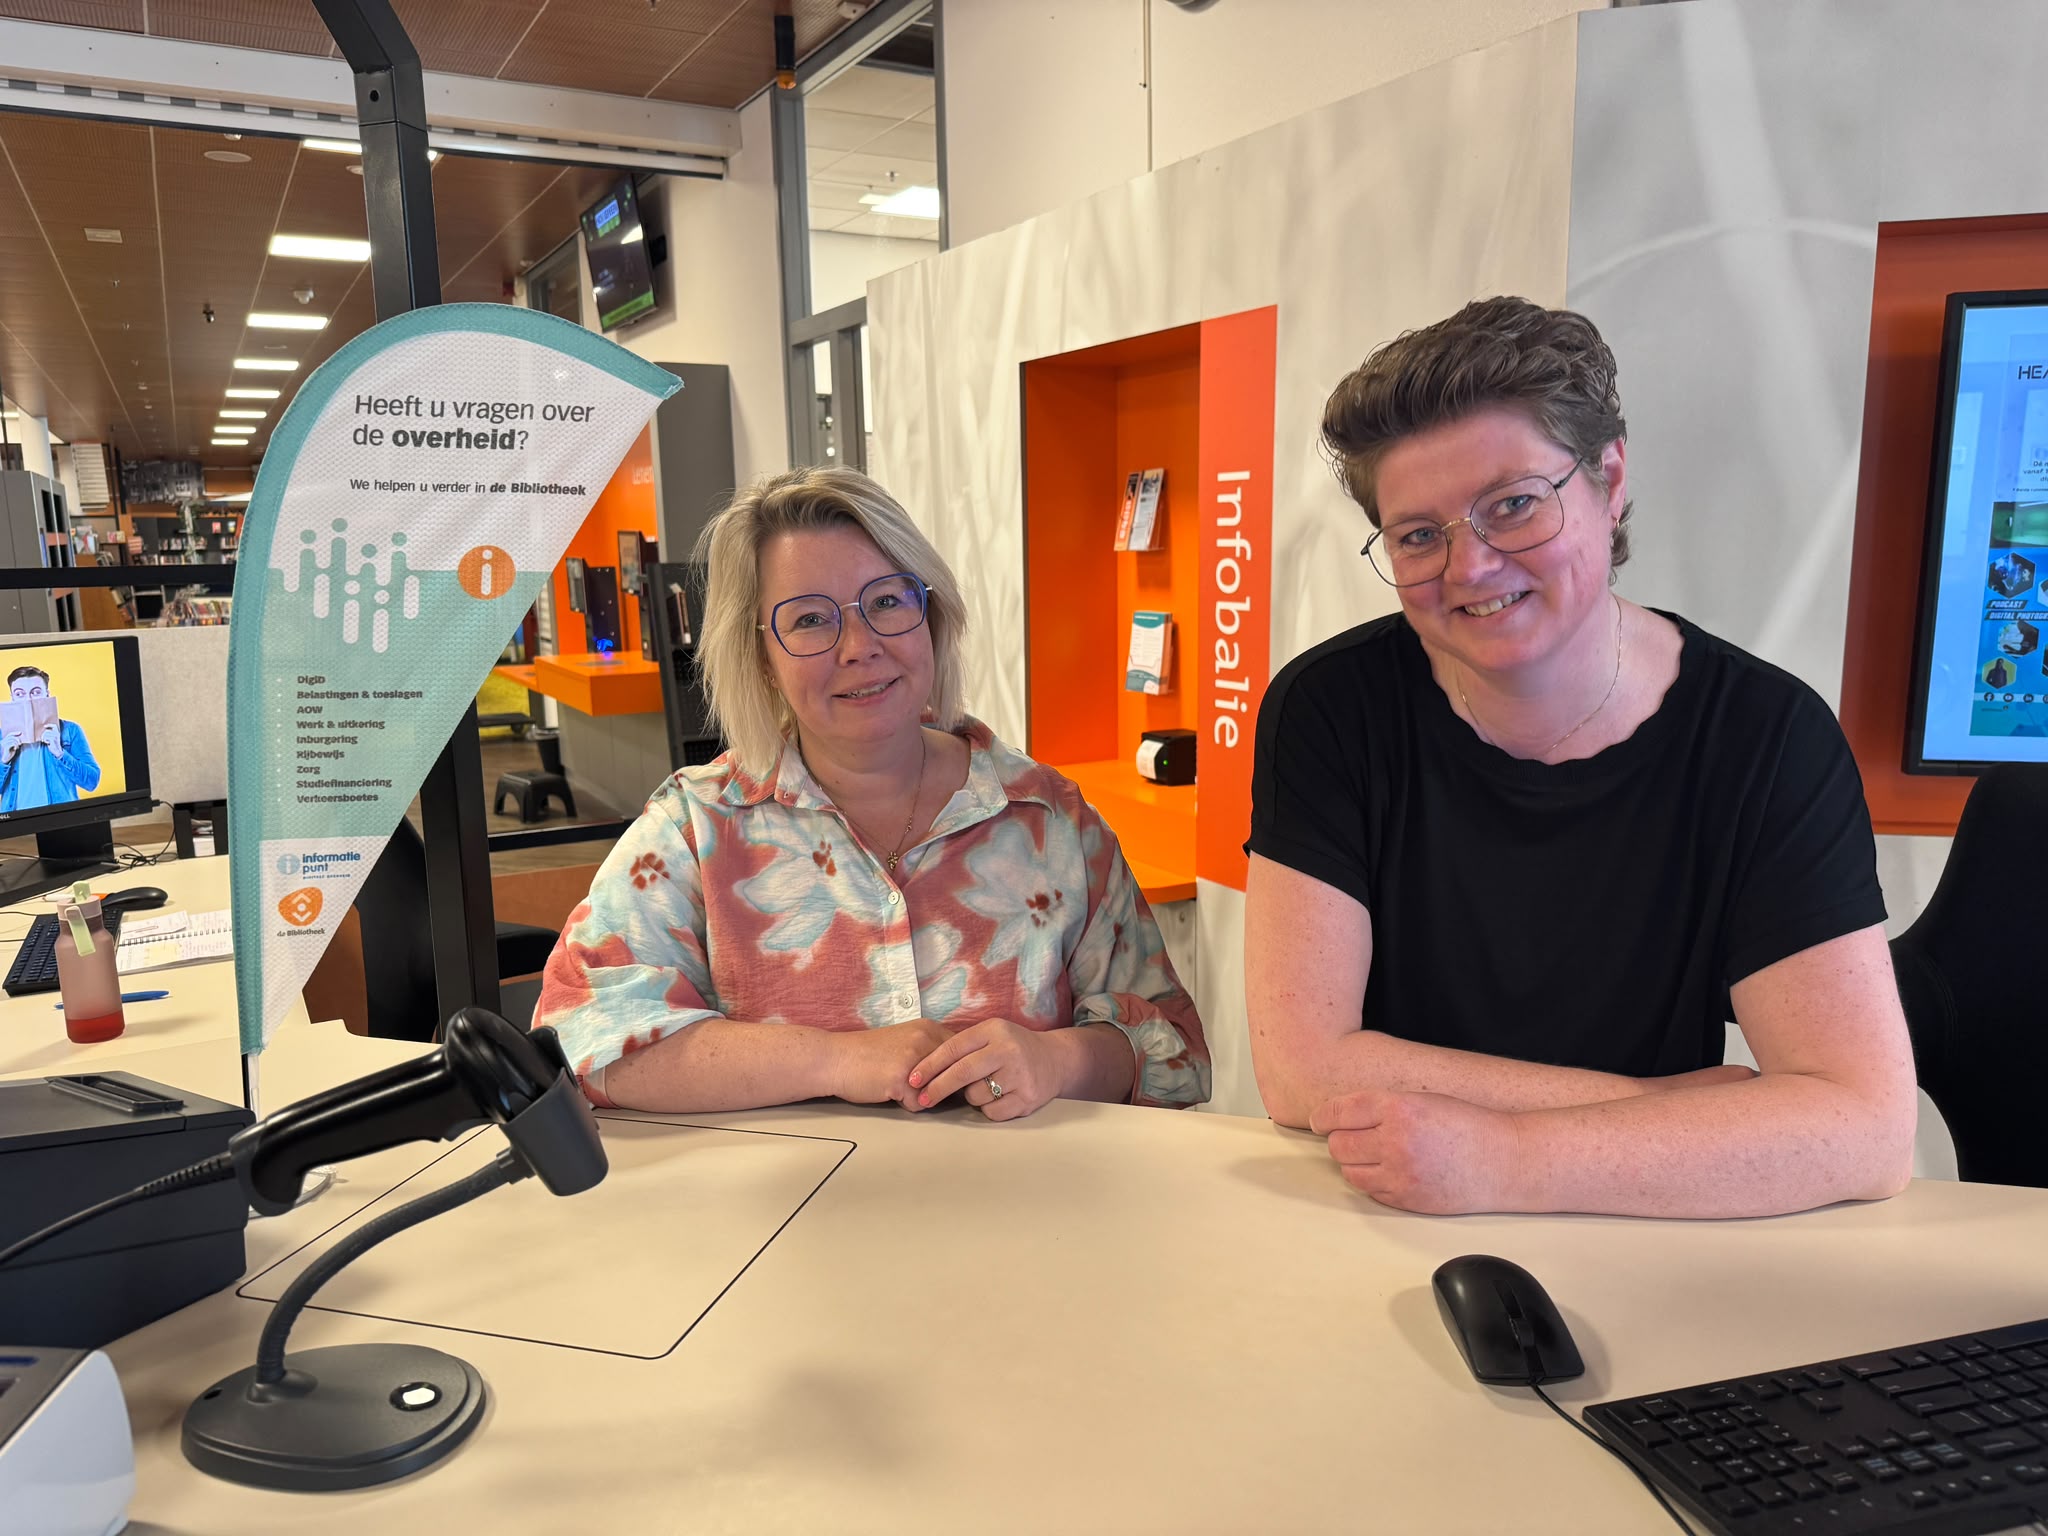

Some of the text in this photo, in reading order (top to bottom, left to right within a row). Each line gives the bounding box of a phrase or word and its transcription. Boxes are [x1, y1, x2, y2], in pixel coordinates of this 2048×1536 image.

[354, 394, 596, 424] Heeft u vragen over
[352, 424, 529, 450] de overheid?
[349, 478, 587, 496] We helpen u verder in de Bibliotheek
[1214, 470, 1252, 749] Infobalie
[1990, 600, 2024, 608] PODCAST
[1989, 612, 2015, 620] DIGITAL
[297, 675, 326, 686] DigiD
[297, 689, 423, 700] Belastingen & toeslagen
[296, 705, 323, 714] AOW
[296, 719, 386, 730] Werk & uitkering
[296, 735, 358, 745] Inburgering
[296, 749, 345, 760] Rijbewijs
[296, 765, 321, 775] Zorg
[296, 778, 393, 789] Studiefinanciering
[297, 793, 379, 804] Verkeersboetes
[302, 851, 361, 863] informatie
[302, 863, 329, 875] punt
[287, 928, 326, 937] Bibliotheek
